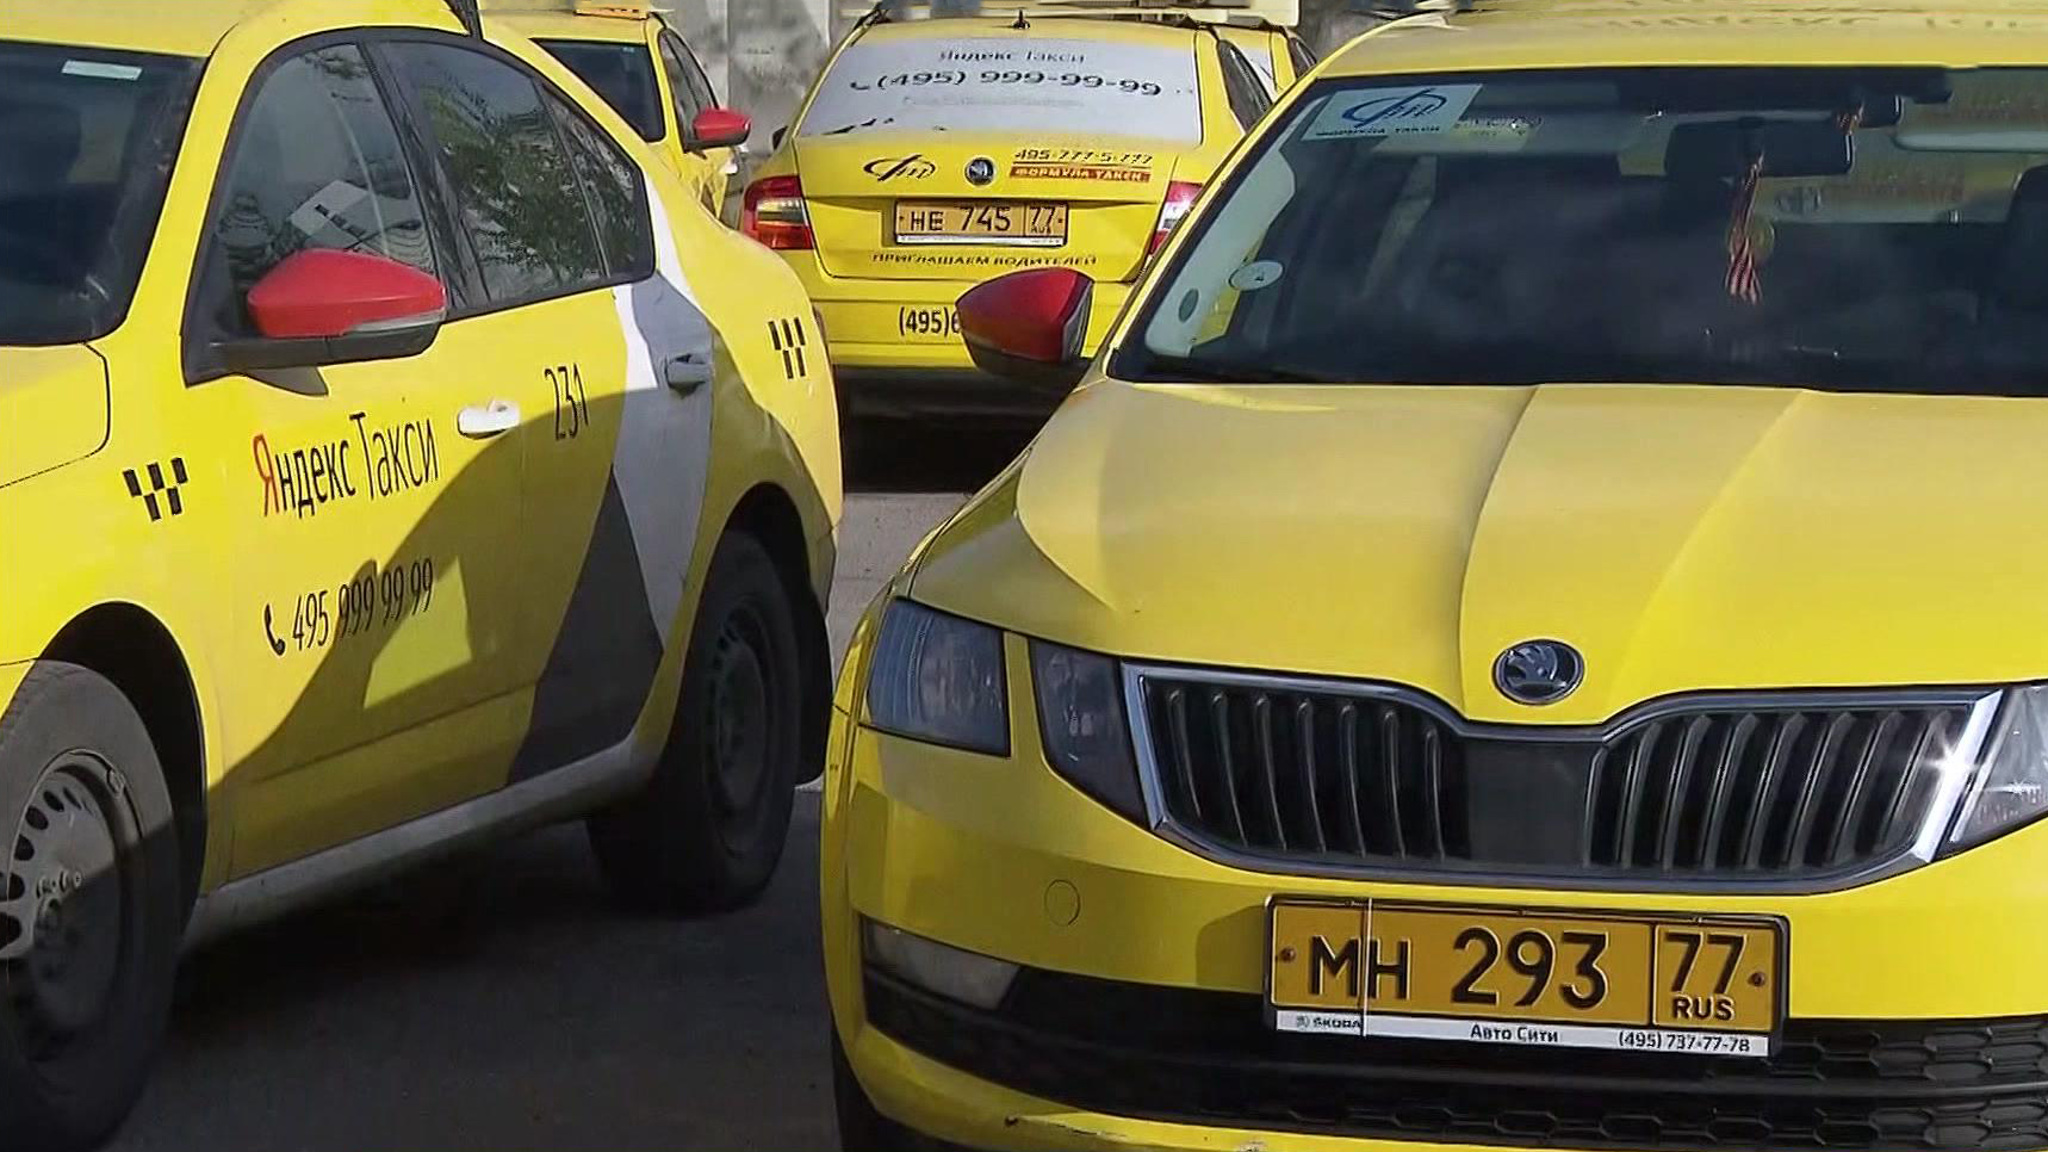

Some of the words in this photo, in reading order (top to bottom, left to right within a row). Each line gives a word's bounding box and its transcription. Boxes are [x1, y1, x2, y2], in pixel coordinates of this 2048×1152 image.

[877, 71, 967, 90] (495)
[980, 70, 1162, 96] 999-99-99
[910, 210, 944, 232] НЕ
[958, 205, 1011, 232] 745
[1029, 206, 1057, 226] 77
[544, 363, 589, 441] 231
[253, 432, 357, 519] Яндекс
[349, 411, 440, 501] Такси
[292, 589, 330, 651] 495
[338, 576, 375, 639] 999
[381, 565, 404, 626] 99
[410, 557, 434, 616] 99
[1310, 934, 1410, 1000] МН
[1451, 927, 1609, 1009] 293
[1663, 931, 1746, 993] 77
[1672, 993, 1735, 1021] RUS
[1470, 1024, 1512, 1040] Авто
[1517, 1026, 1559, 1043] Сити
[1618, 1030, 1662, 1049] (495)
[1667, 1034, 1750, 1052] 737-77-78
